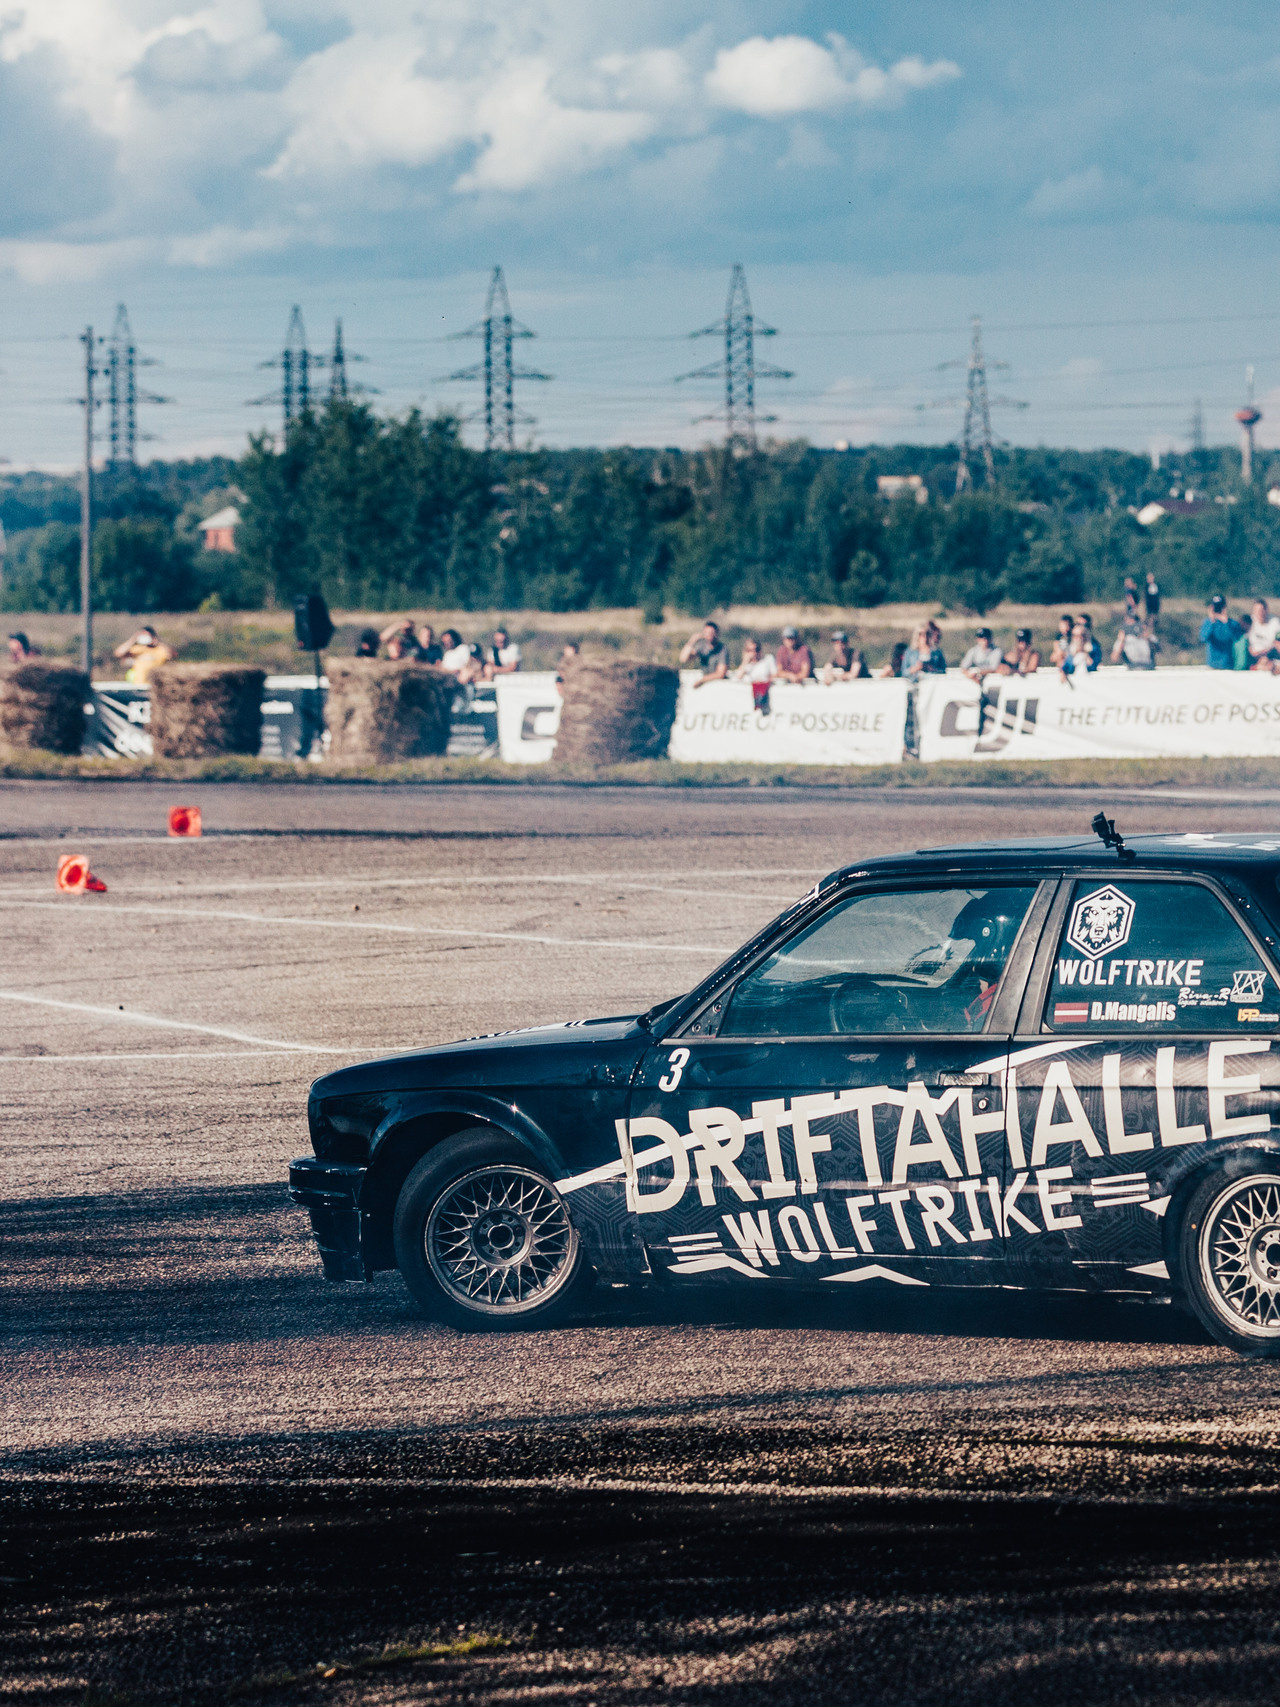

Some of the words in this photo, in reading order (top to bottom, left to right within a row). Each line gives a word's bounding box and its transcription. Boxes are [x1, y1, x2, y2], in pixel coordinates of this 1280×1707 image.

[682, 712, 751, 731] UTURE
[790, 712, 885, 732] POSSIBLE
[1058, 706, 1099, 726] THE
[1101, 704, 1189, 726] FUTURE
[1193, 703, 1225, 725] OF
[1058, 959, 1204, 986] WOLFTRIKE
[1090, 1001, 1177, 1023] D.Mangalis
[658, 1047, 691, 1093] 3
[721, 1165, 1083, 1267] WOLFTRIKE
